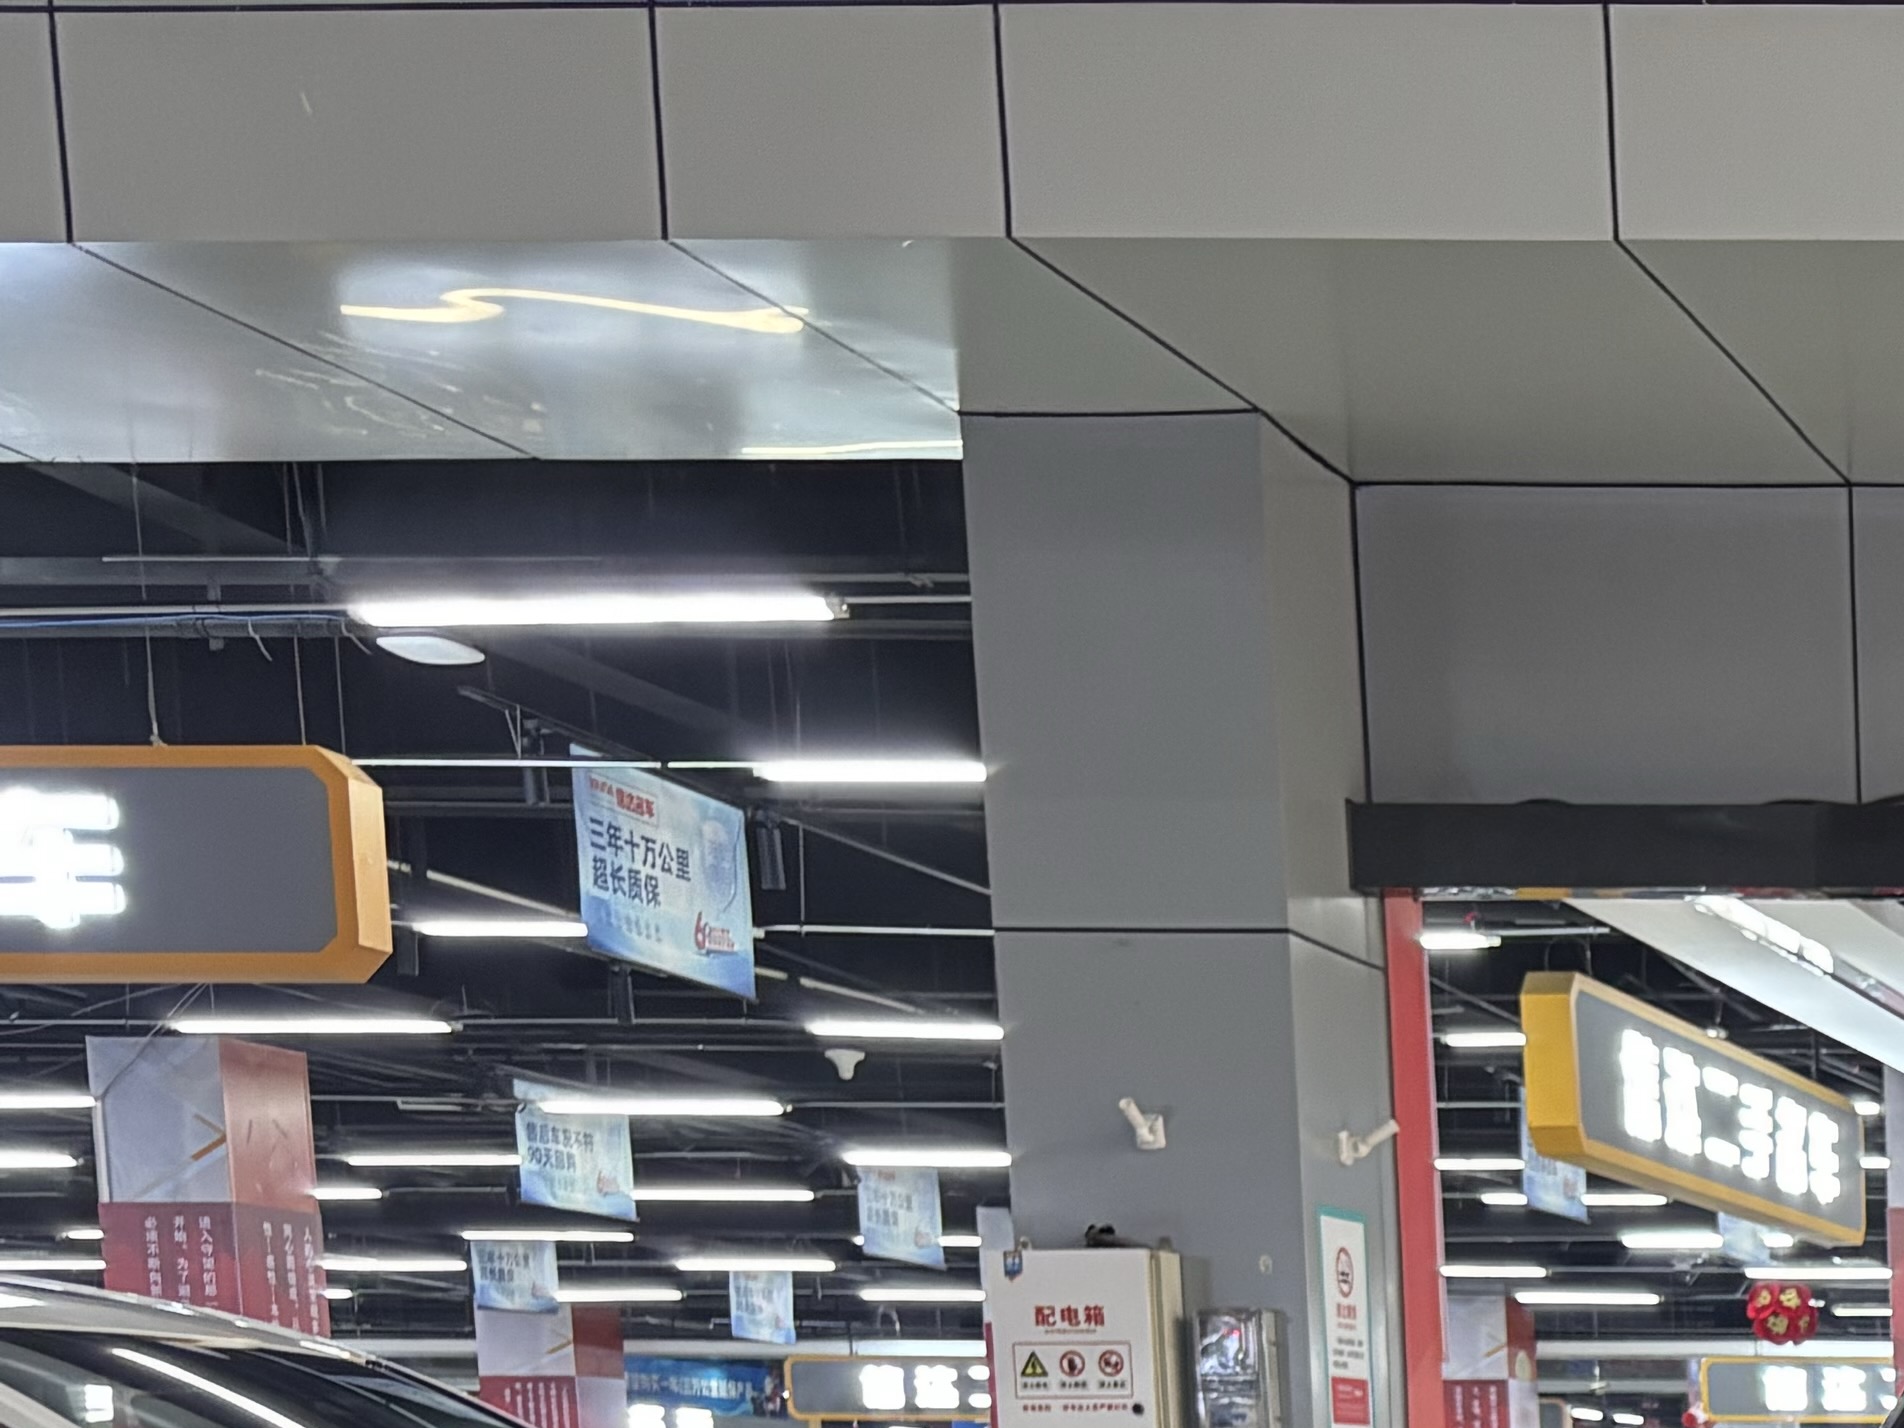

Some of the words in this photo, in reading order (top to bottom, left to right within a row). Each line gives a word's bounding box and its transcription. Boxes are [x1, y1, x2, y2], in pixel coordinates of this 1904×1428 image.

[589, 815, 692, 882] 三年十万公里
[591, 854, 662, 908] 超长质保
[1033, 1304, 1106, 1327] 配电箱
